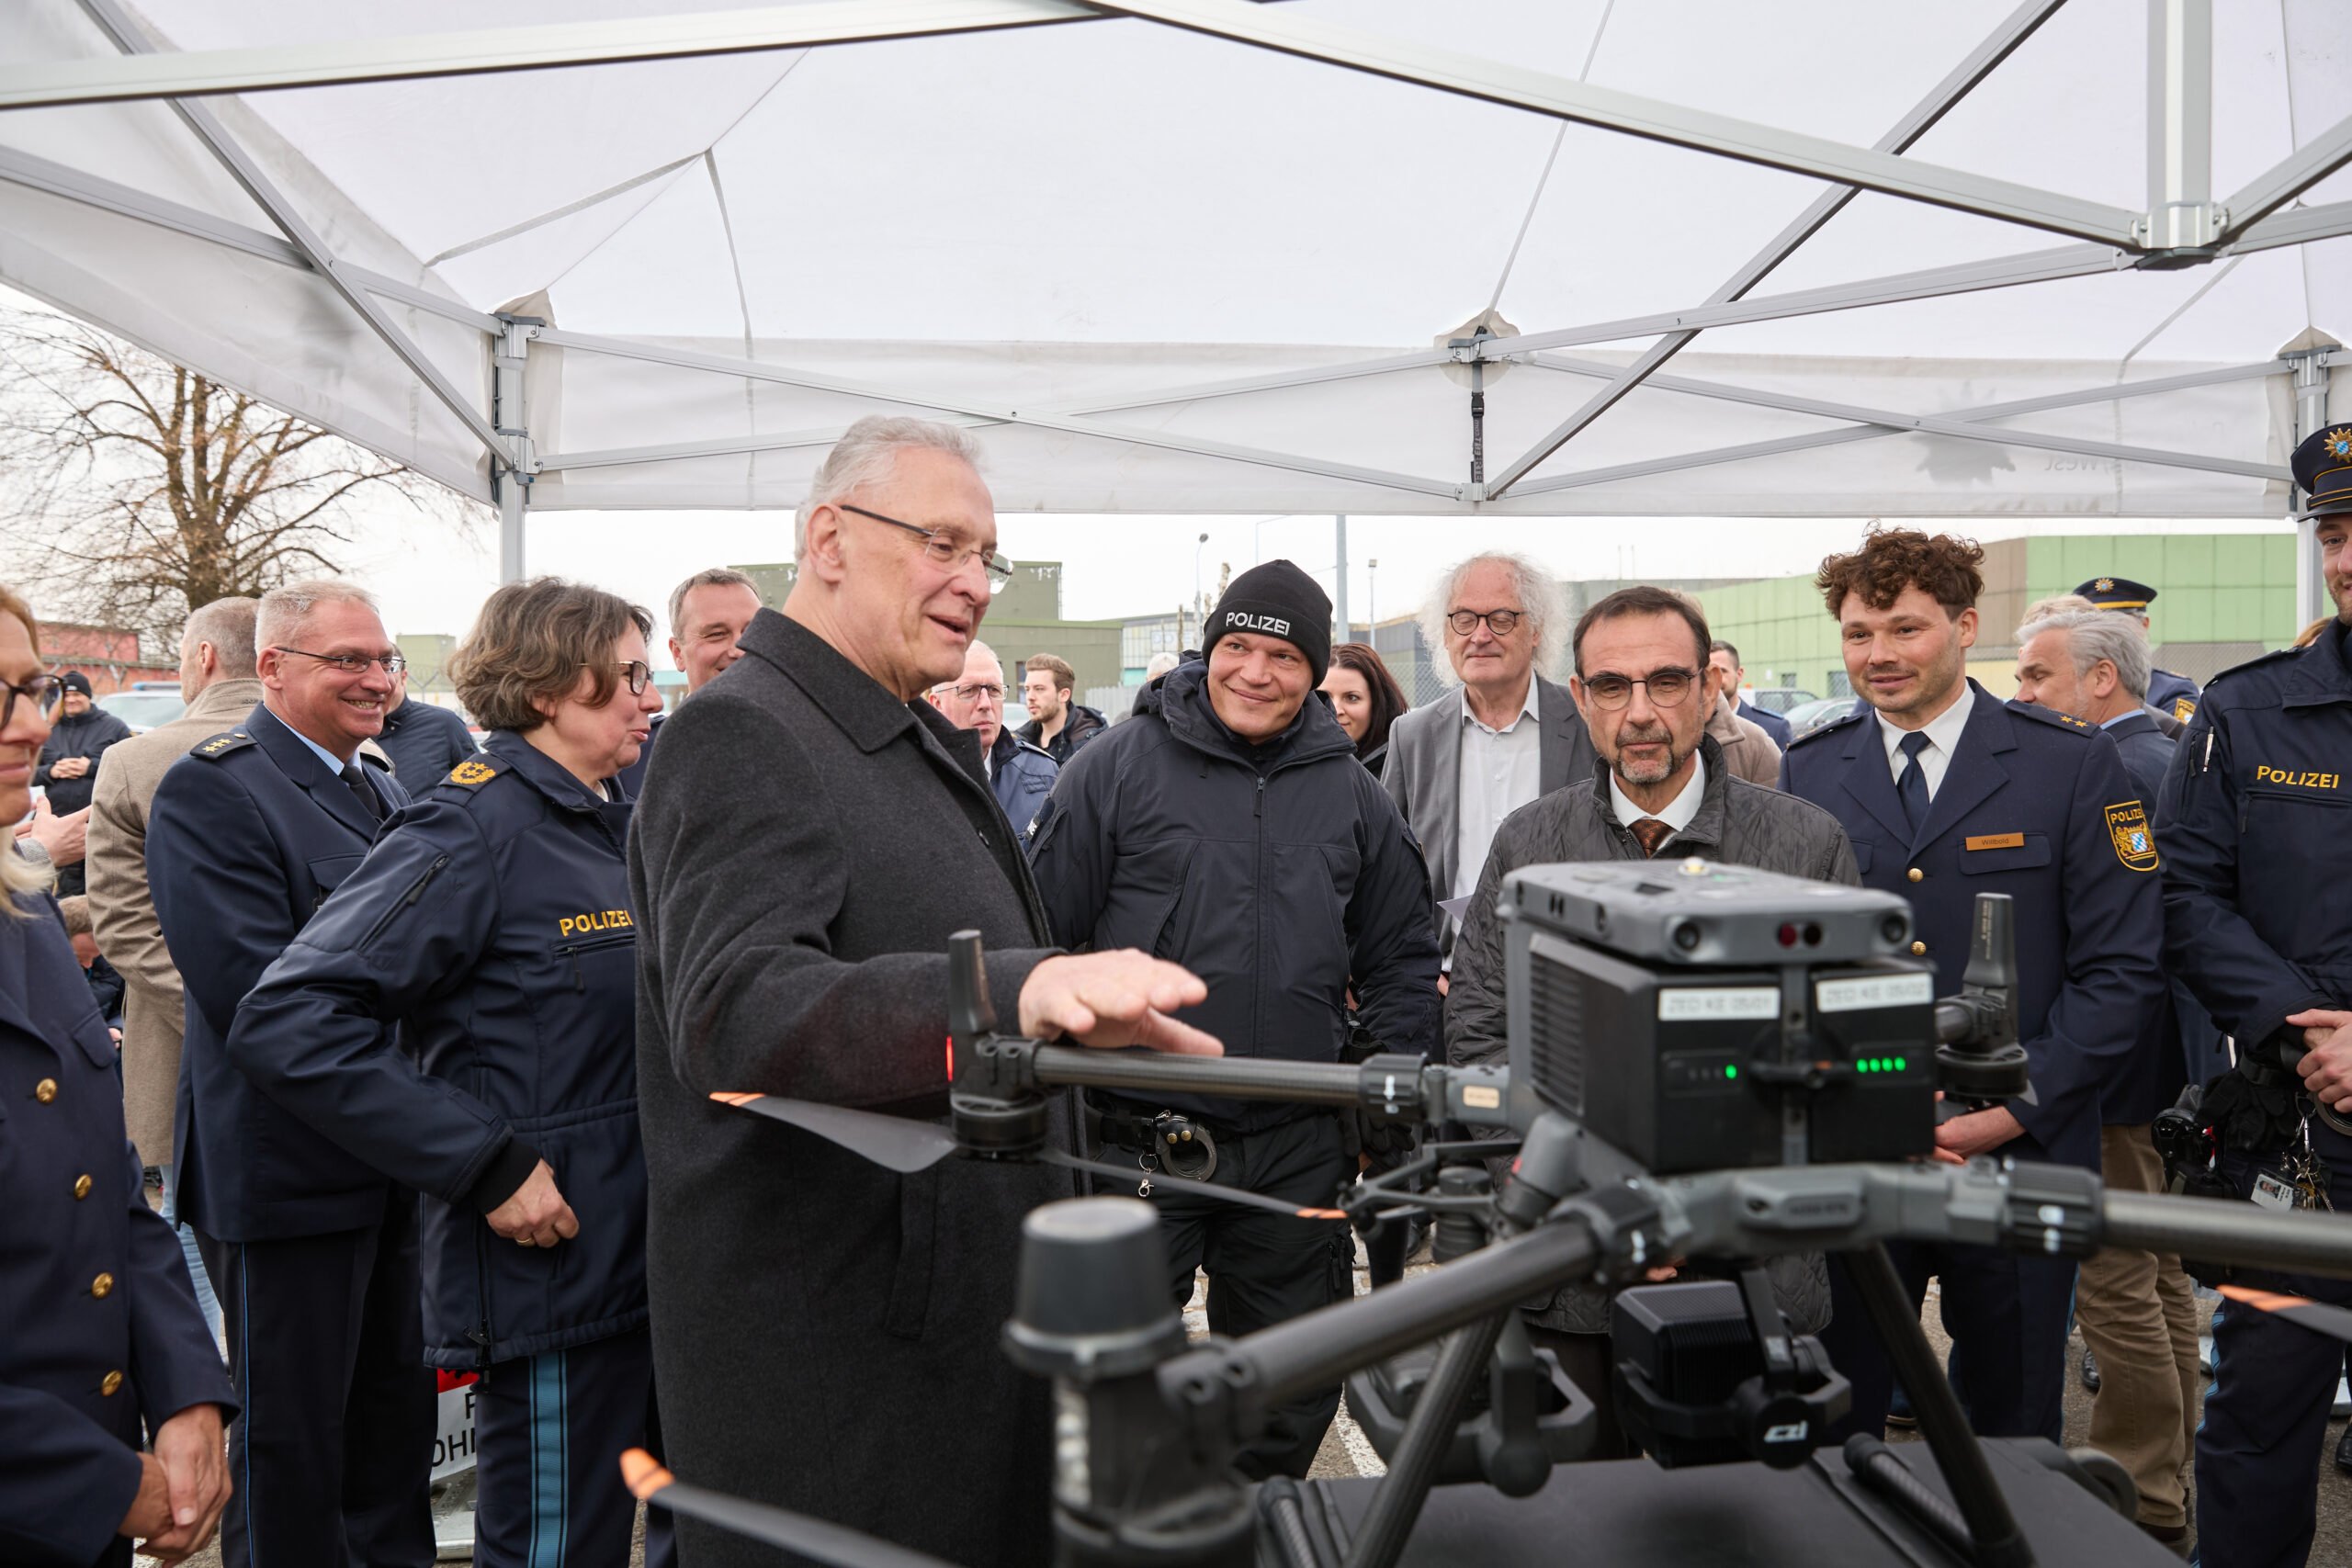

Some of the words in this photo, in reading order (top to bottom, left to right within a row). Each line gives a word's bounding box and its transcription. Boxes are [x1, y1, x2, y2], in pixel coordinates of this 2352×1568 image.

[1226, 612, 1290, 636] POLIZEI
[2256, 765, 2339, 788] POLIZEI
[559, 909, 634, 937] POLIZEI
